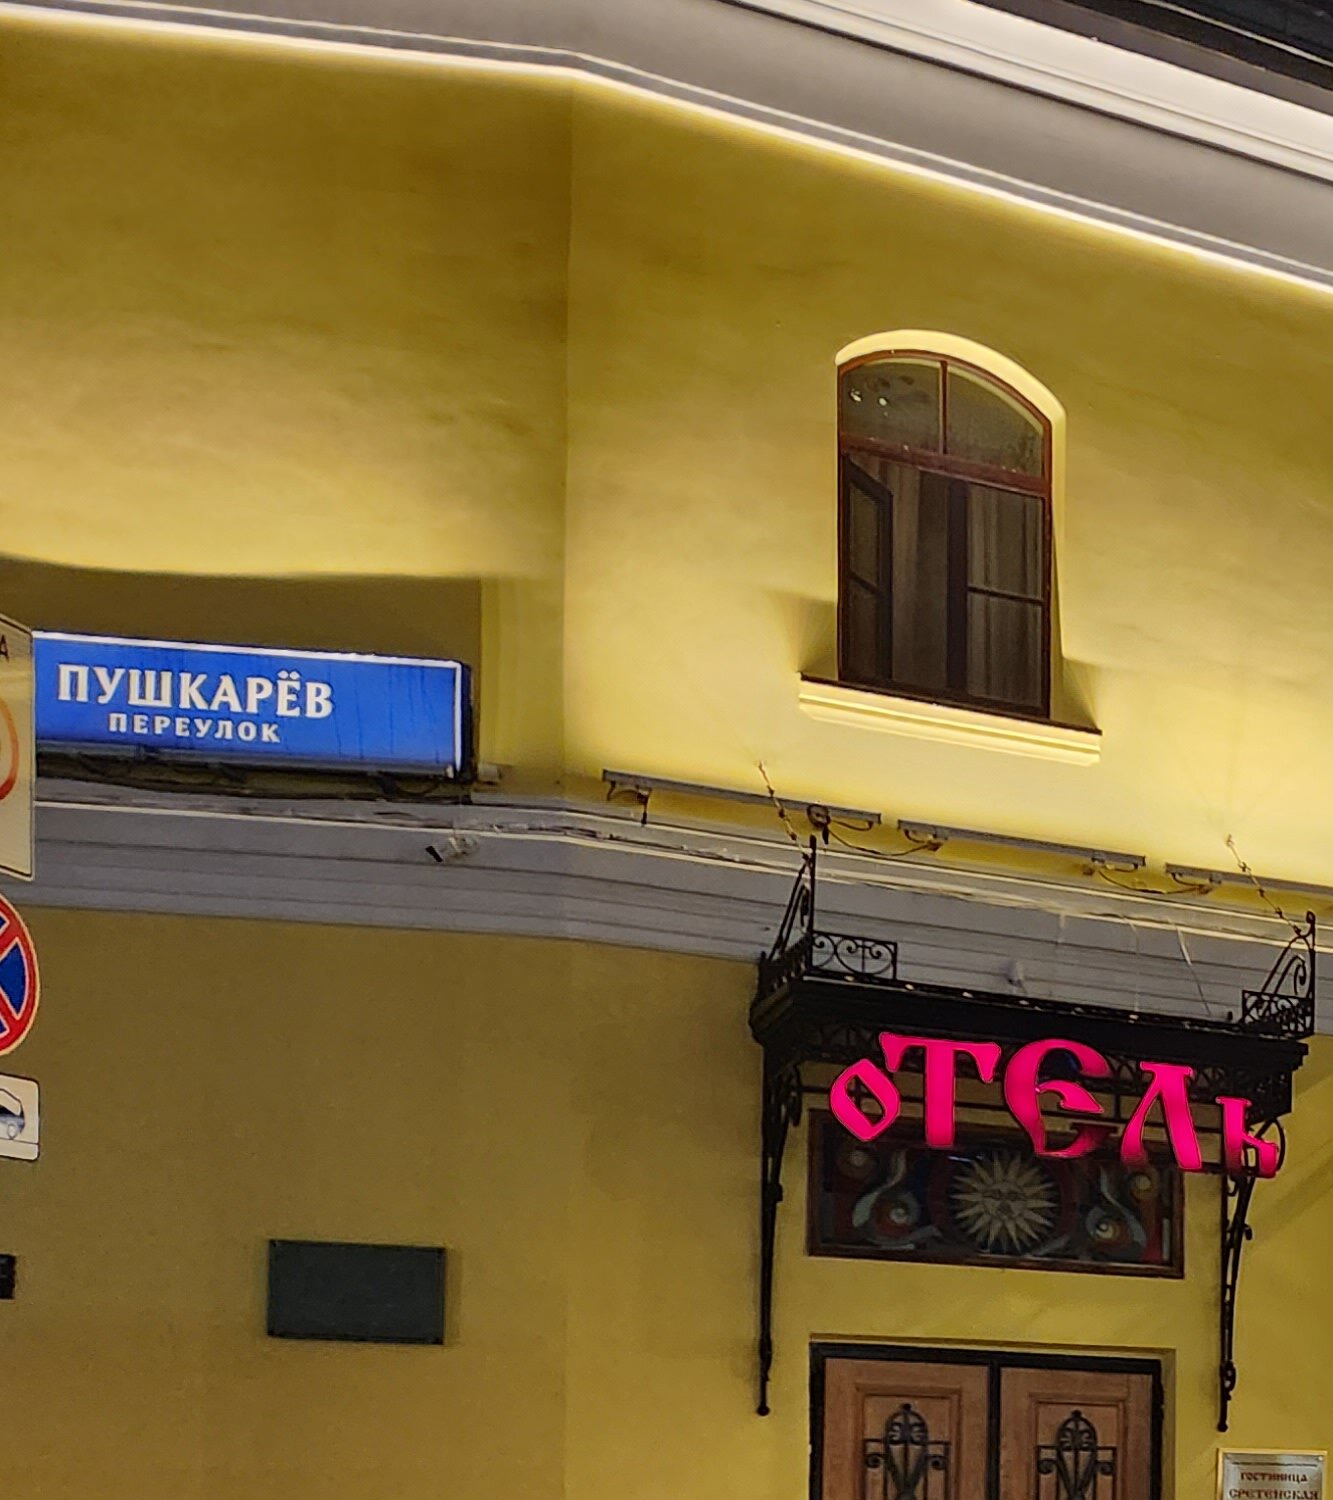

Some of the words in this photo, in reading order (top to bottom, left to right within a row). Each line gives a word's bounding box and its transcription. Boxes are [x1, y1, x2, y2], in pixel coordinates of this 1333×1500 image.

[57, 663, 334, 719] ПУШКАРЁВ
[108, 712, 281, 743] ПЕРЕУЛОК
[1228, 1488, 1320, 1500] СРЕТЕНСКАЯ
